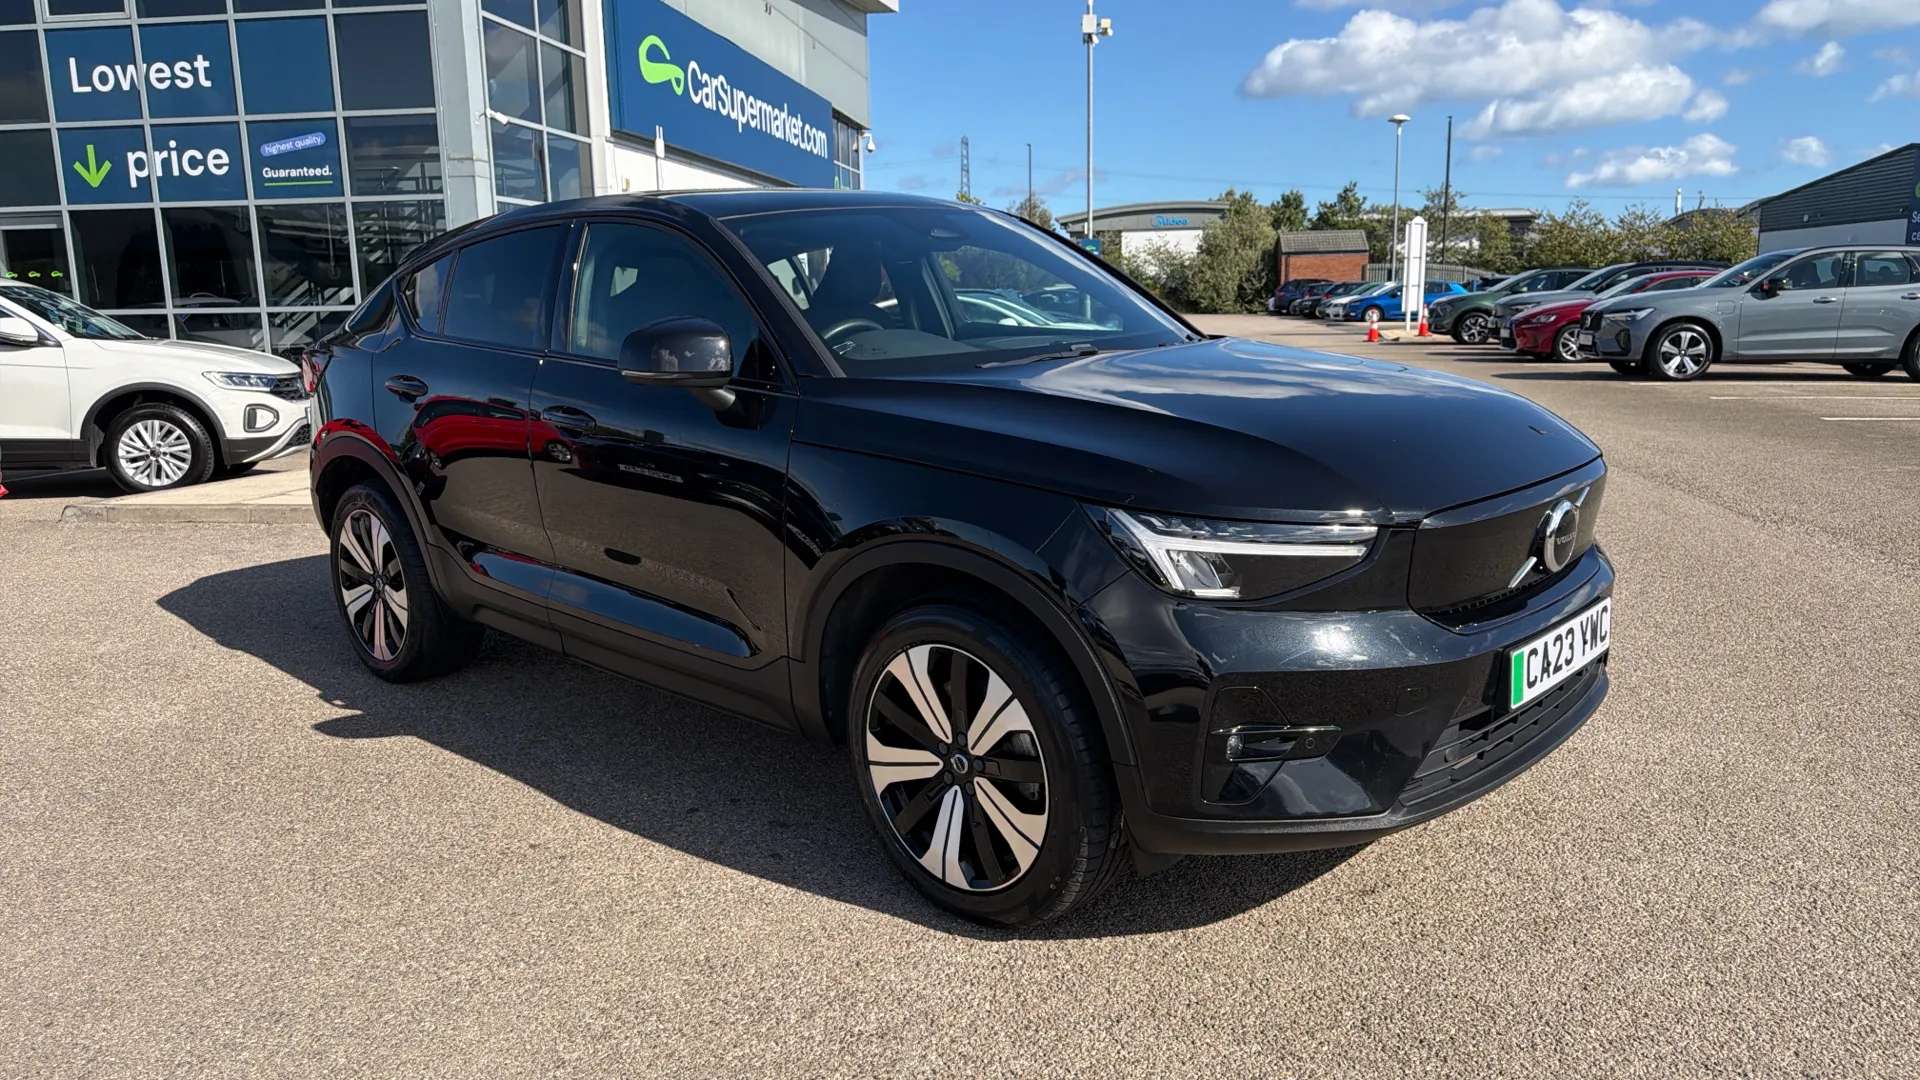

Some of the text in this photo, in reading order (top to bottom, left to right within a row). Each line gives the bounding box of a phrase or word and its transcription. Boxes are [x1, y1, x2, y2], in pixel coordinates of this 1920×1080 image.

[69, 54, 212, 93] Lowest
[687, 60, 828, 158] CarSupermarket.com
[127, 140, 230, 188] price
[262, 165, 333, 178] Guaranteed.
[1526, 605, 1609, 689] CA23 YWC
